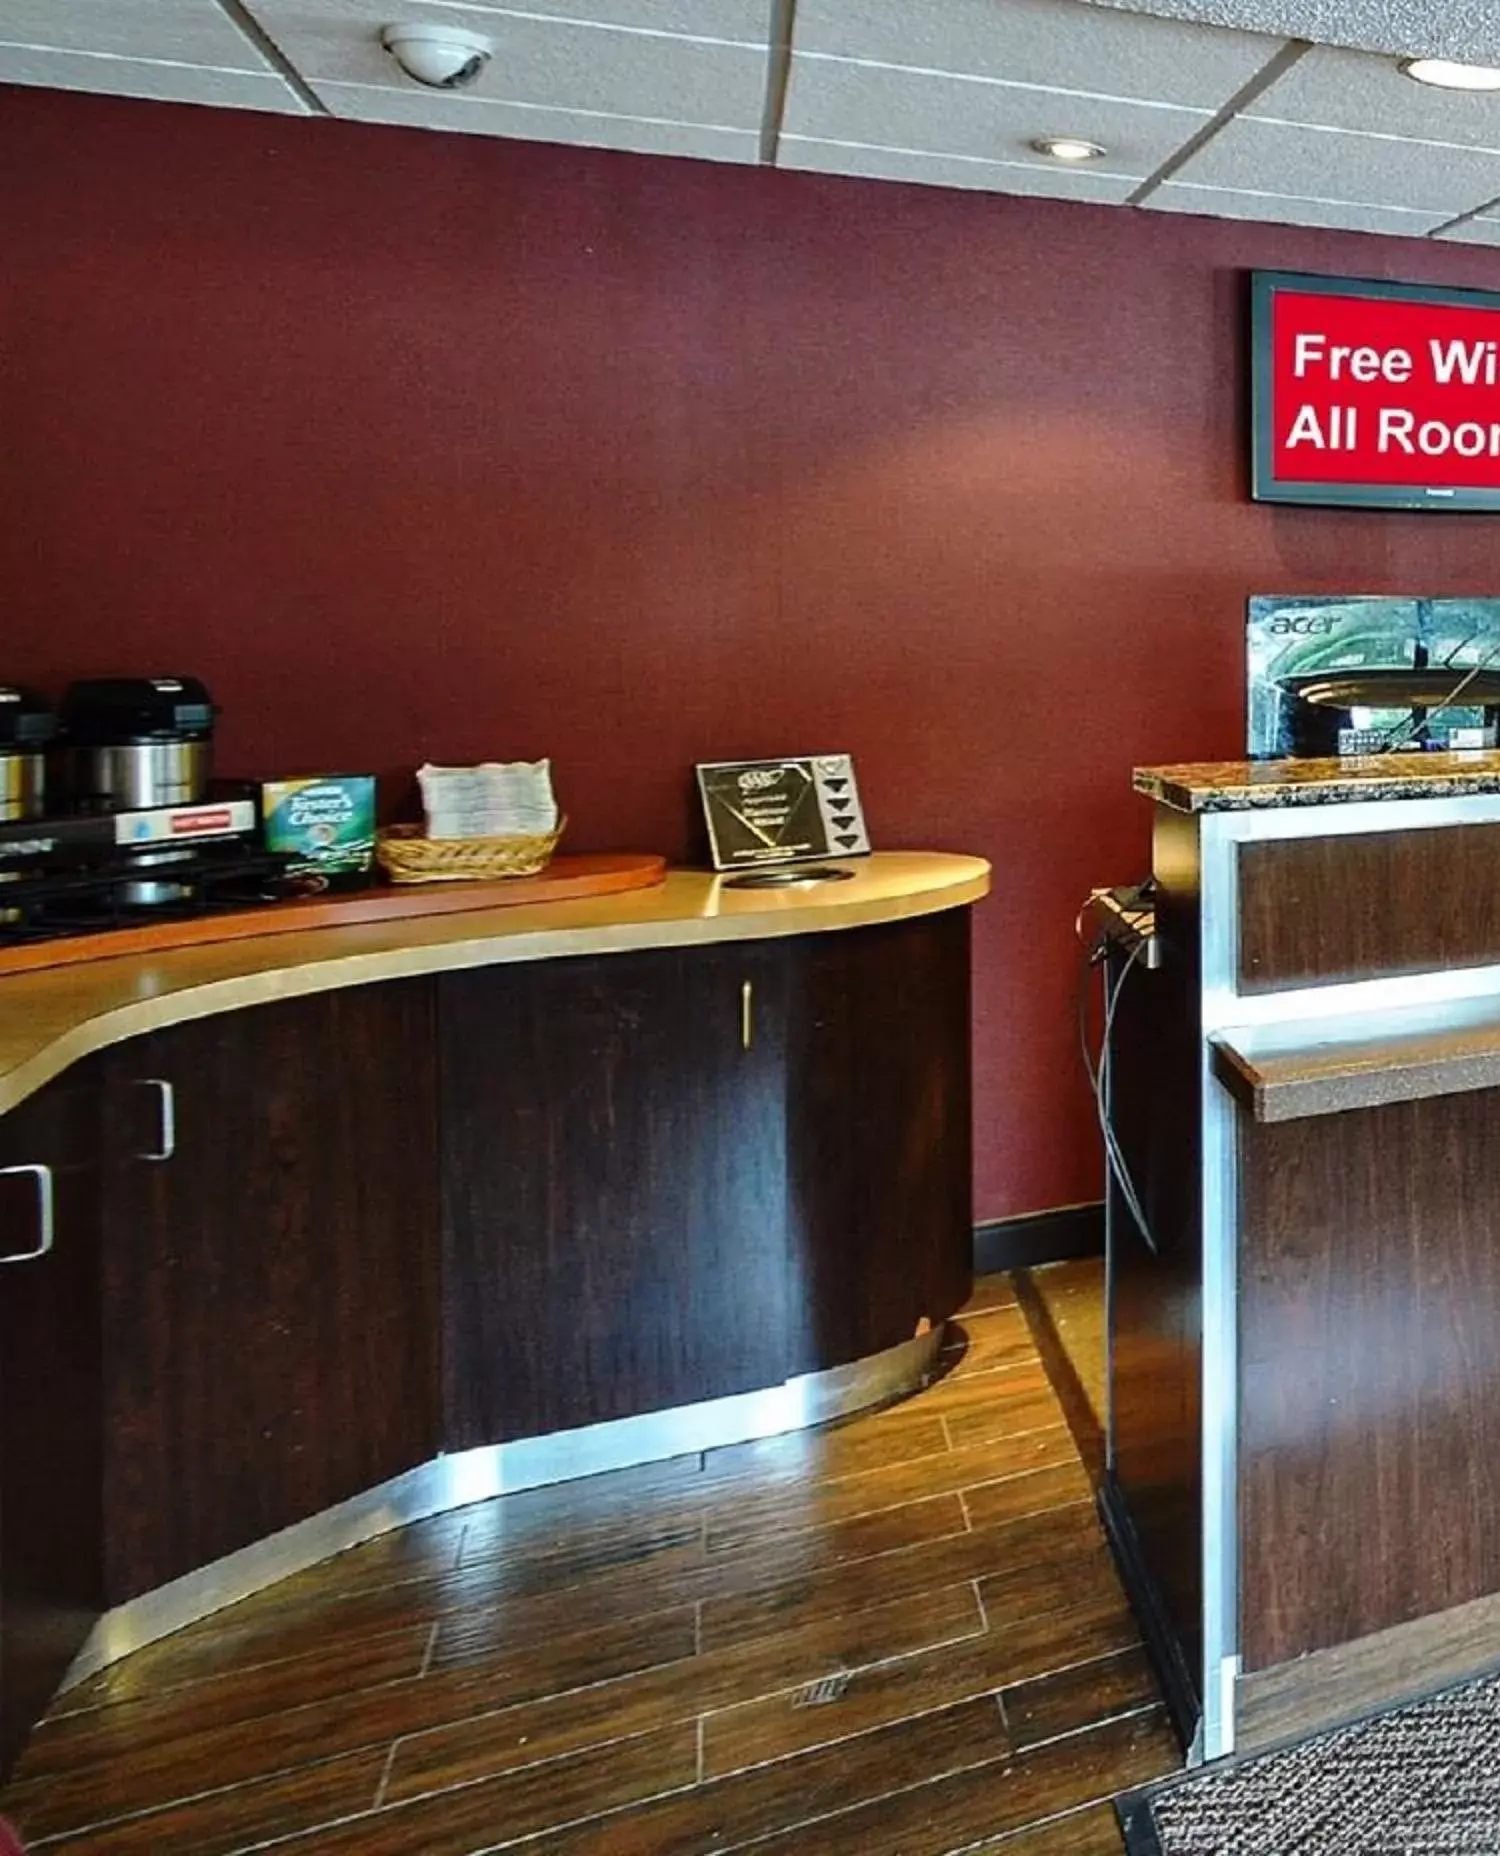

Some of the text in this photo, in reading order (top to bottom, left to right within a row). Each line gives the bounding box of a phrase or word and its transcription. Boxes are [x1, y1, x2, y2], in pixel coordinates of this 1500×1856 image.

[1294, 333, 1413, 383] Free
[1285, 404, 1358, 450] All
[1270, 616, 1342, 635] acer
